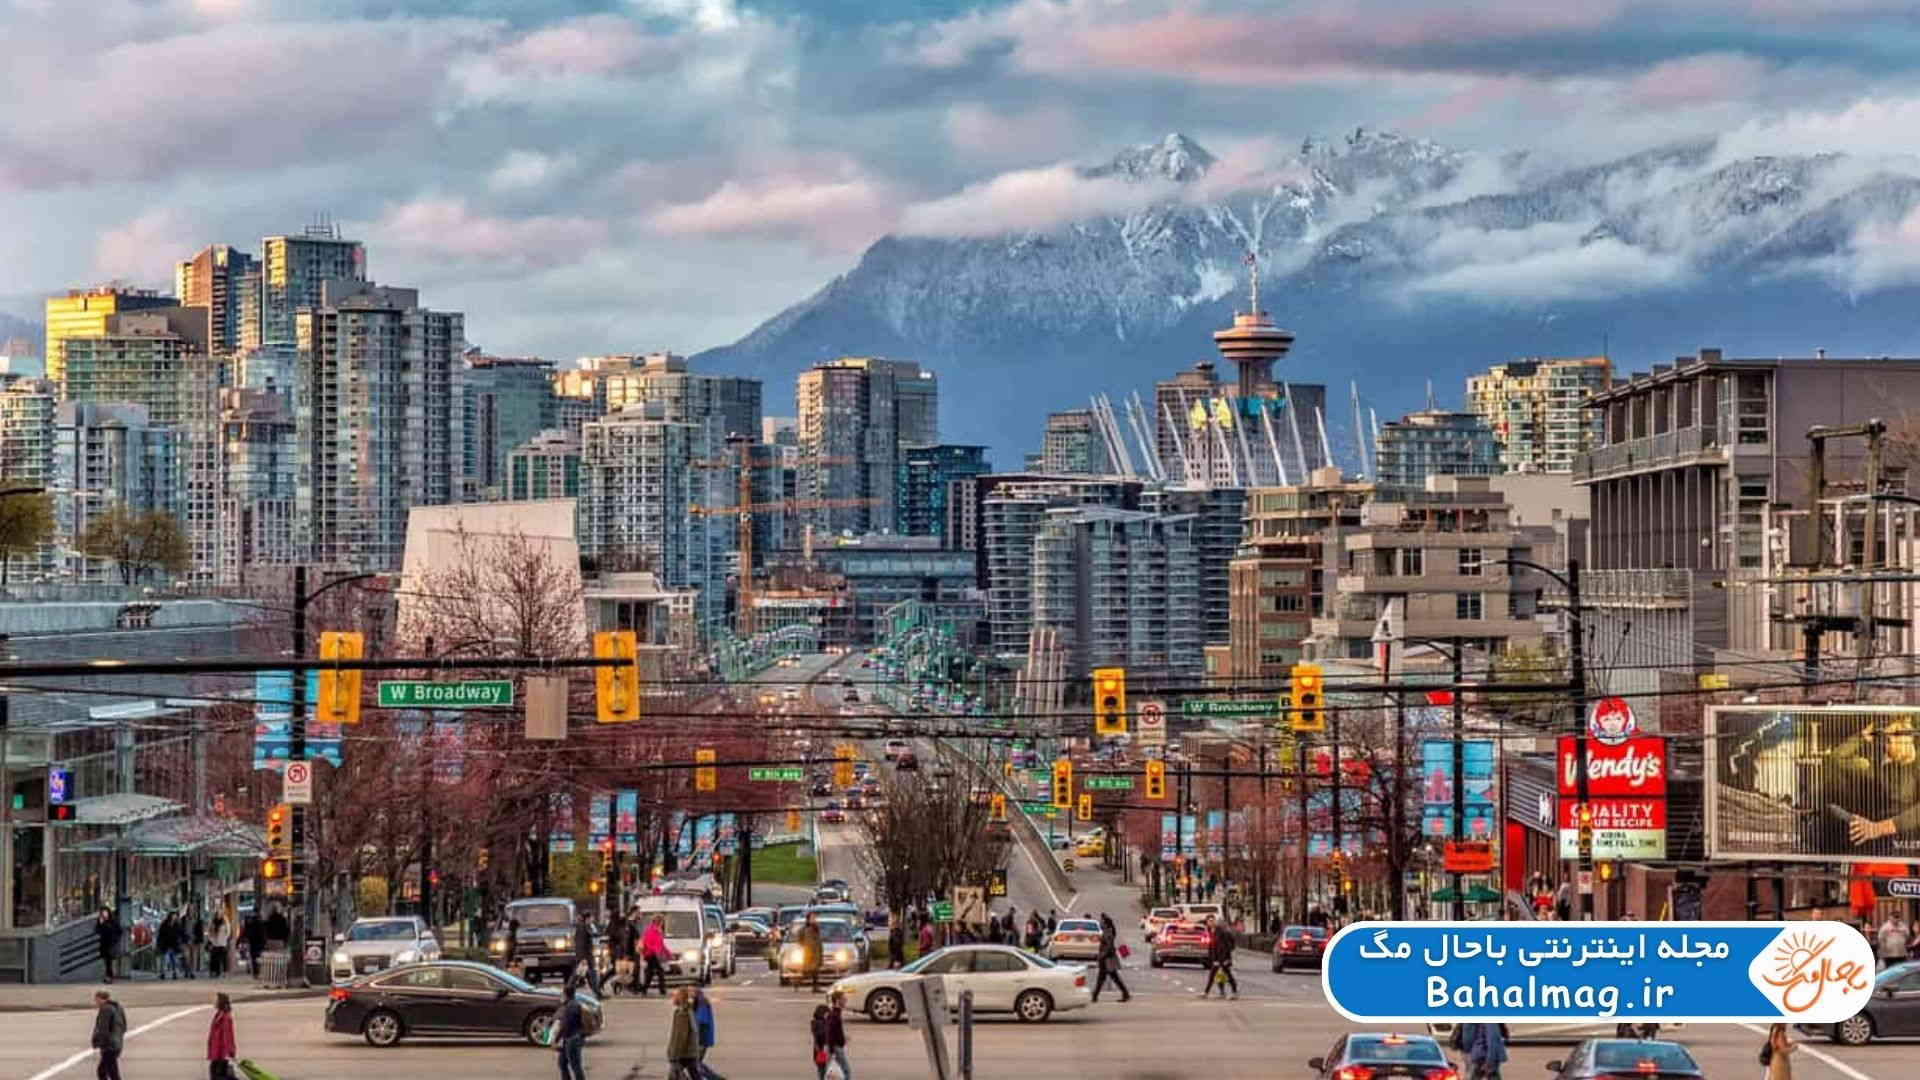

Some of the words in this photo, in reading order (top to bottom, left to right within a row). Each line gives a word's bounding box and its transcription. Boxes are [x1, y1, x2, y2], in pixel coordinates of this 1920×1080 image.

[391, 686, 406, 699] W
[415, 685, 501, 702] Broadway
[1564, 746, 1661, 787] Wendy's
